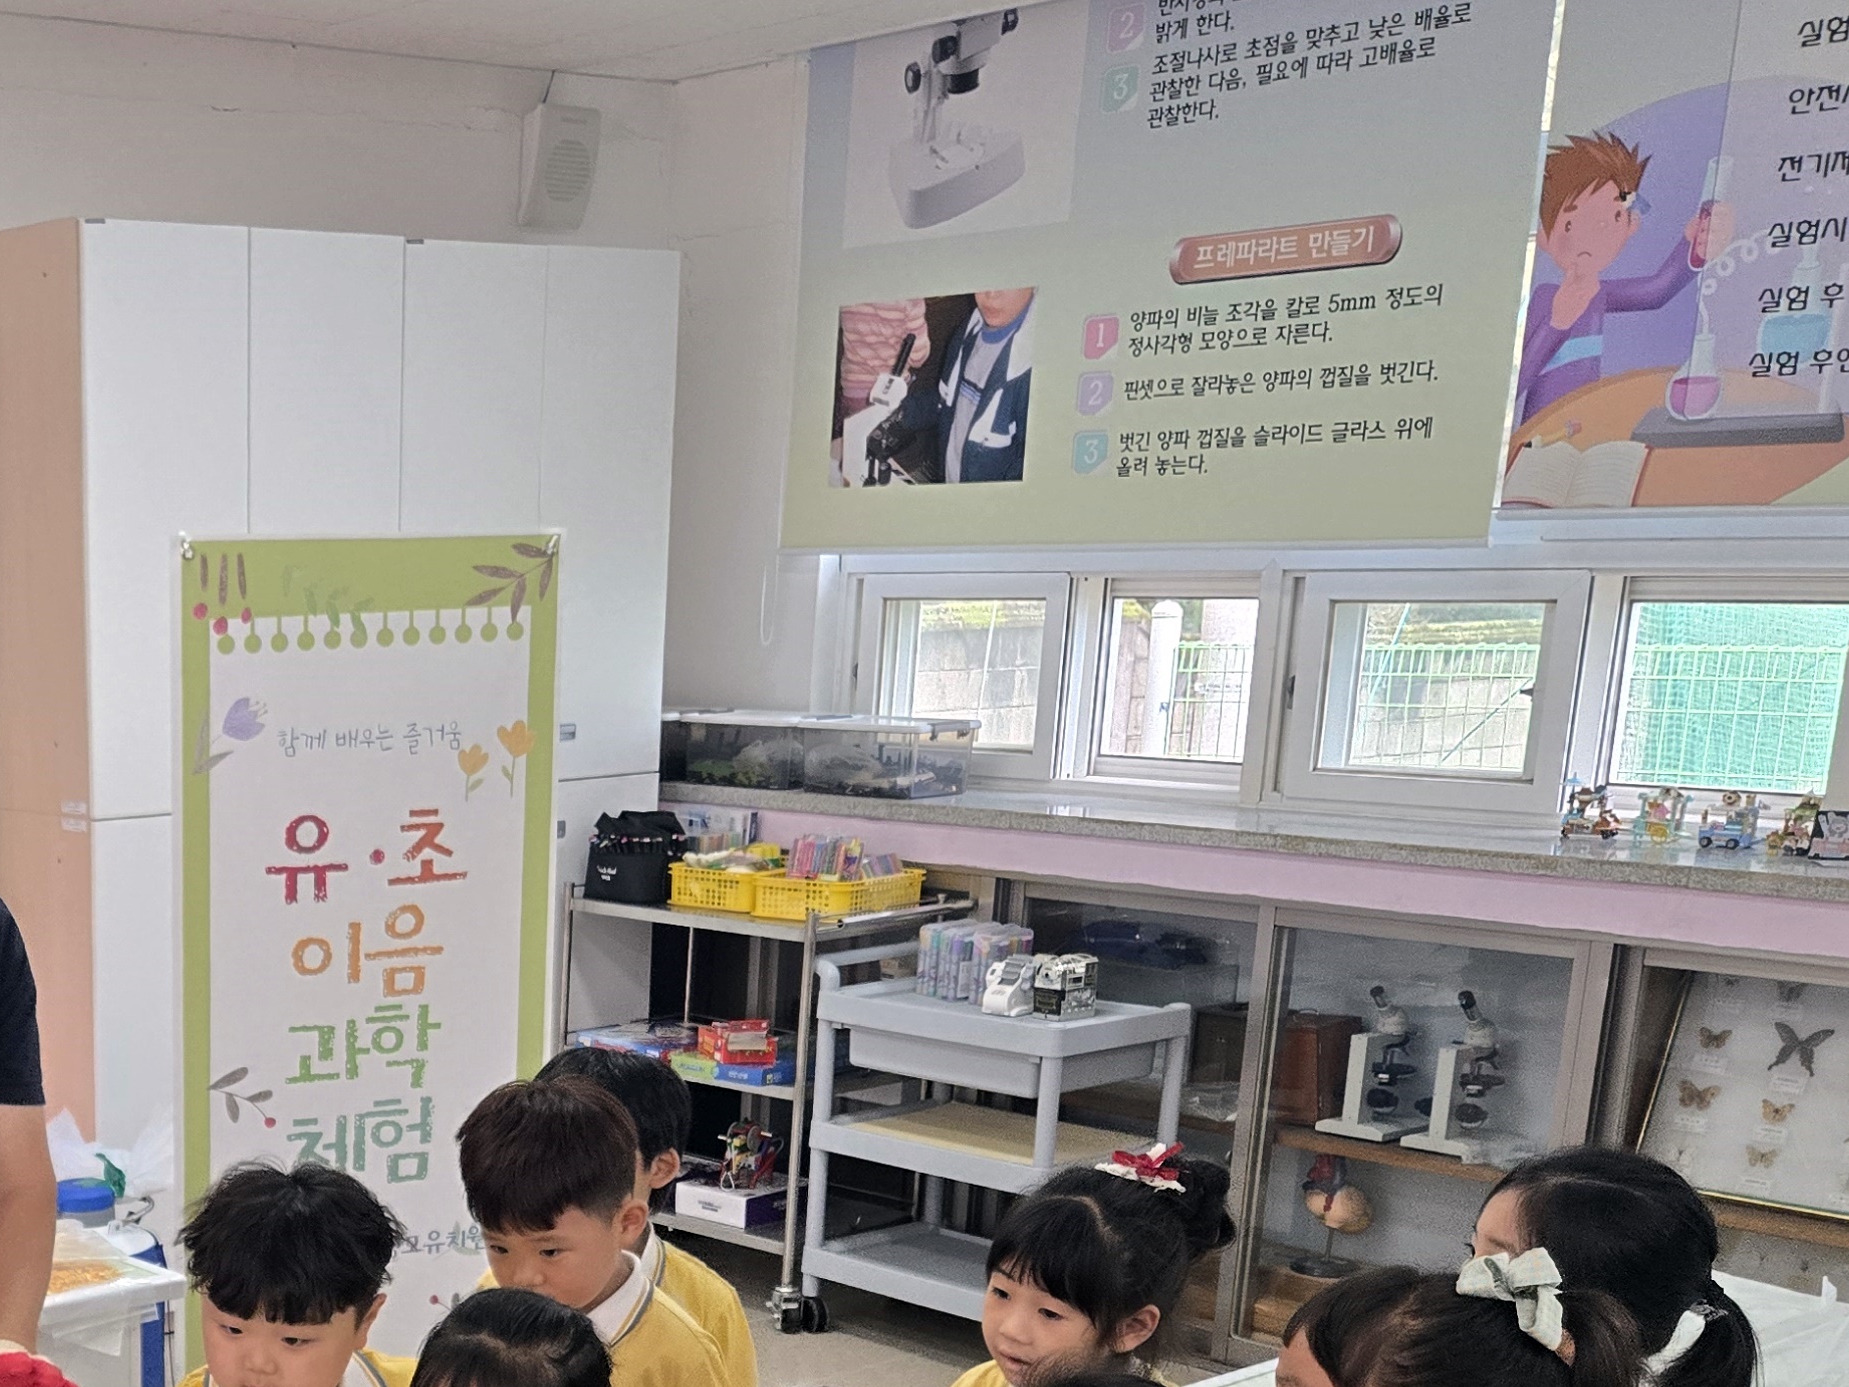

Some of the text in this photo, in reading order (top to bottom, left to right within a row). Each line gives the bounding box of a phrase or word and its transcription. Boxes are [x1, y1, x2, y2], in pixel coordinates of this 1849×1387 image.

[1119, 11, 1135, 39] 2
[1152, 2, 1471, 75] 조절나사로 초점을 맞추고 낮은 배율로
[1155, 10, 1234, 44] 밝게 한다.
[1113, 73, 1128, 99] 3
[1149, 36, 1436, 102] 관찰한 다음, 필요에 따라 고배율로
[1147, 99, 1219, 129] 관찰한다.
[1789, 84, 1849, 115] 안전
[1193, 225, 1375, 268] 프레파라트 만들기
[1130, 283, 1444, 333] 양파의 비늘 조각을 칼로 5mm 정도의
[1758, 282, 1845, 313] 실험 후
[1096, 323, 1104, 348] 1
[1128, 321, 1333, 358] 정사각형 모양으로 자른다.
[1124, 359, 1438, 401] 핀셋으로 잘라놓은 양파의 껍질을 벗긴다.
[1748, 350, 1800, 378] 실험
[1088, 379, 1103, 406] 2
[1084, 439, 1099, 464] 3
[1119, 416, 1434, 453] 벗긴 양파 껍질을 슬라이드 글라스 위에
[1116, 453, 1208, 478] 올려 놓는다.
[277, 721, 462, 757] 함께 배우는 즐거움
[291, 903, 444, 998] 이음
[285, 1003, 442, 1090] 과학
[286, 1096, 435, 1184] 체험
